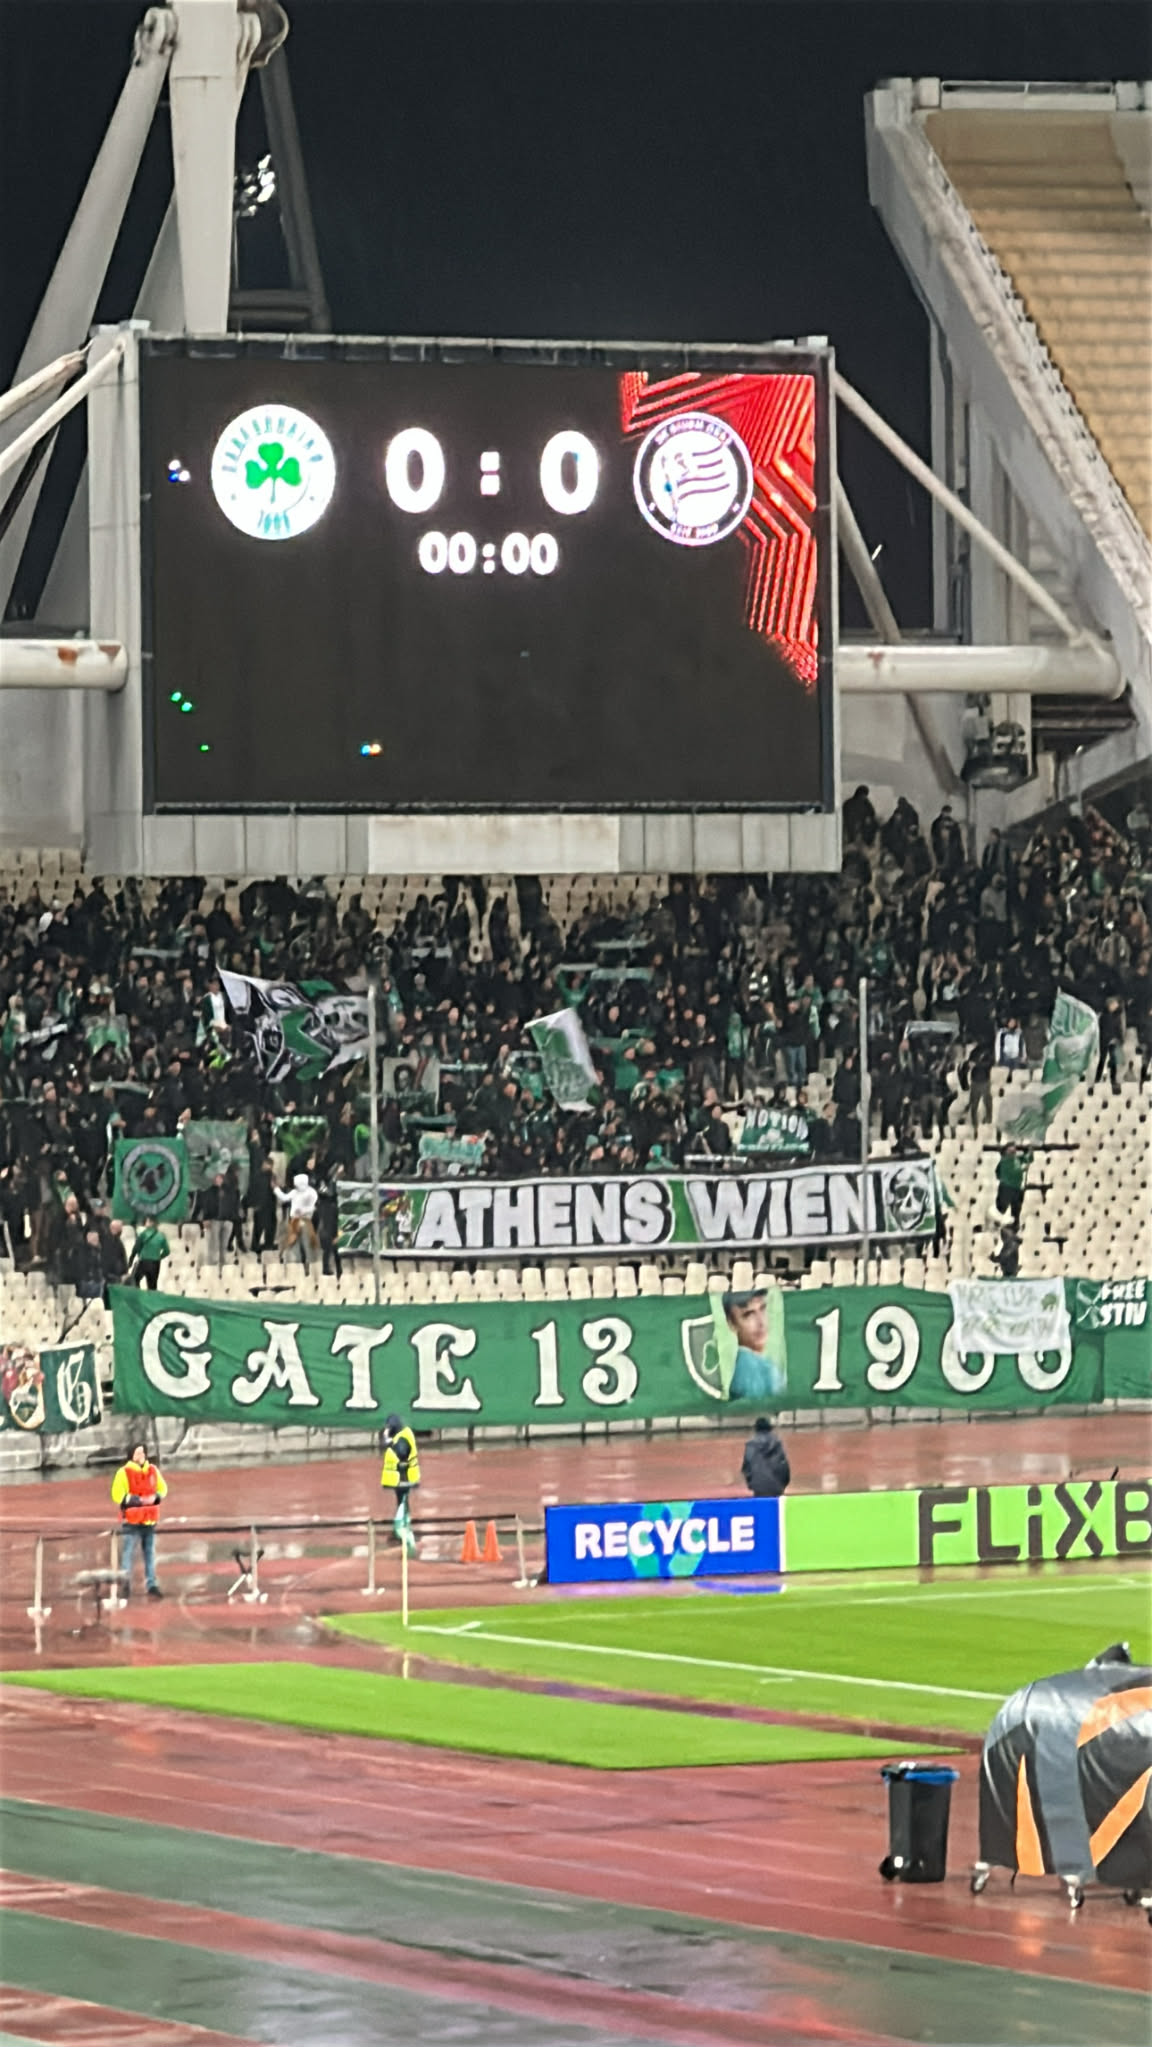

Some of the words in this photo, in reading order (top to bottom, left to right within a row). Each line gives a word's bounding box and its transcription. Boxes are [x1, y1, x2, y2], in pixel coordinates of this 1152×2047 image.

[385, 427, 445, 514] 0
[540, 430, 599, 515] 0
[418, 530, 559, 576] 00:00
[412, 1178, 673, 1249] ATHENS
[685, 1171, 878, 1241] WIEN
[1101, 1279, 1147, 1300] FREE
[141, 1310, 482, 1411] GATE
[531, 1317, 639, 1407] 13
[575, 1516, 755, 1560] RECYCLE
